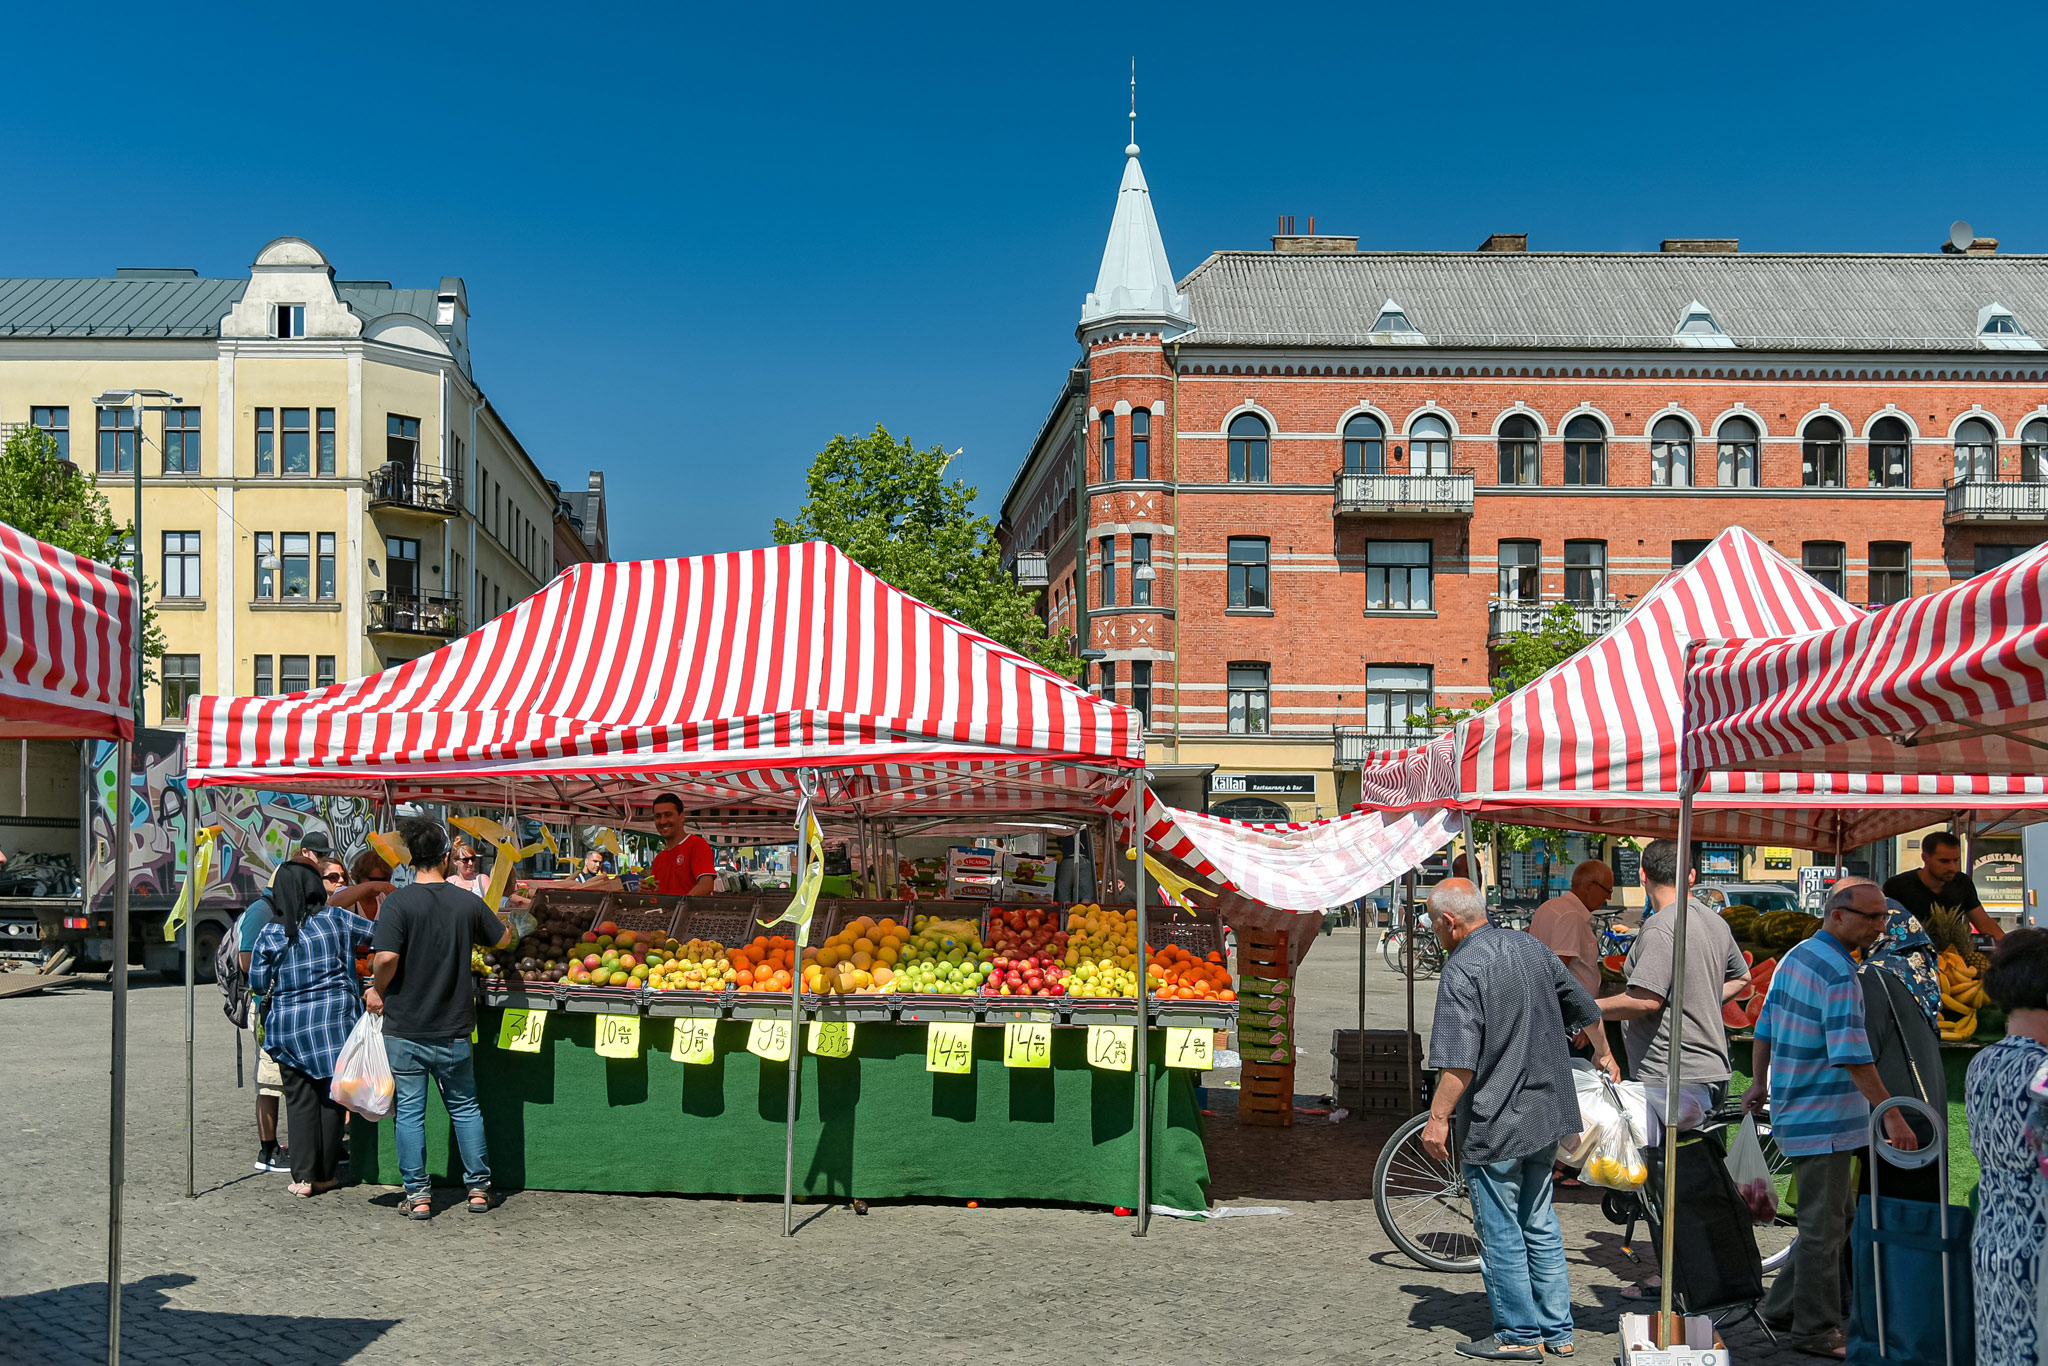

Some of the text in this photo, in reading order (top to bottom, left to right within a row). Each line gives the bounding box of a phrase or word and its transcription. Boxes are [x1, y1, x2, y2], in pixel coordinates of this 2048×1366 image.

[1213, 777, 1246, 790] Källan
[1804, 869, 1822, 879] DET
[601, 1013, 617, 1047] 10
[1008, 1024, 1034, 1062] 14
[1094, 1028, 1116, 1064] 12
[932, 1030, 956, 1067] 14
